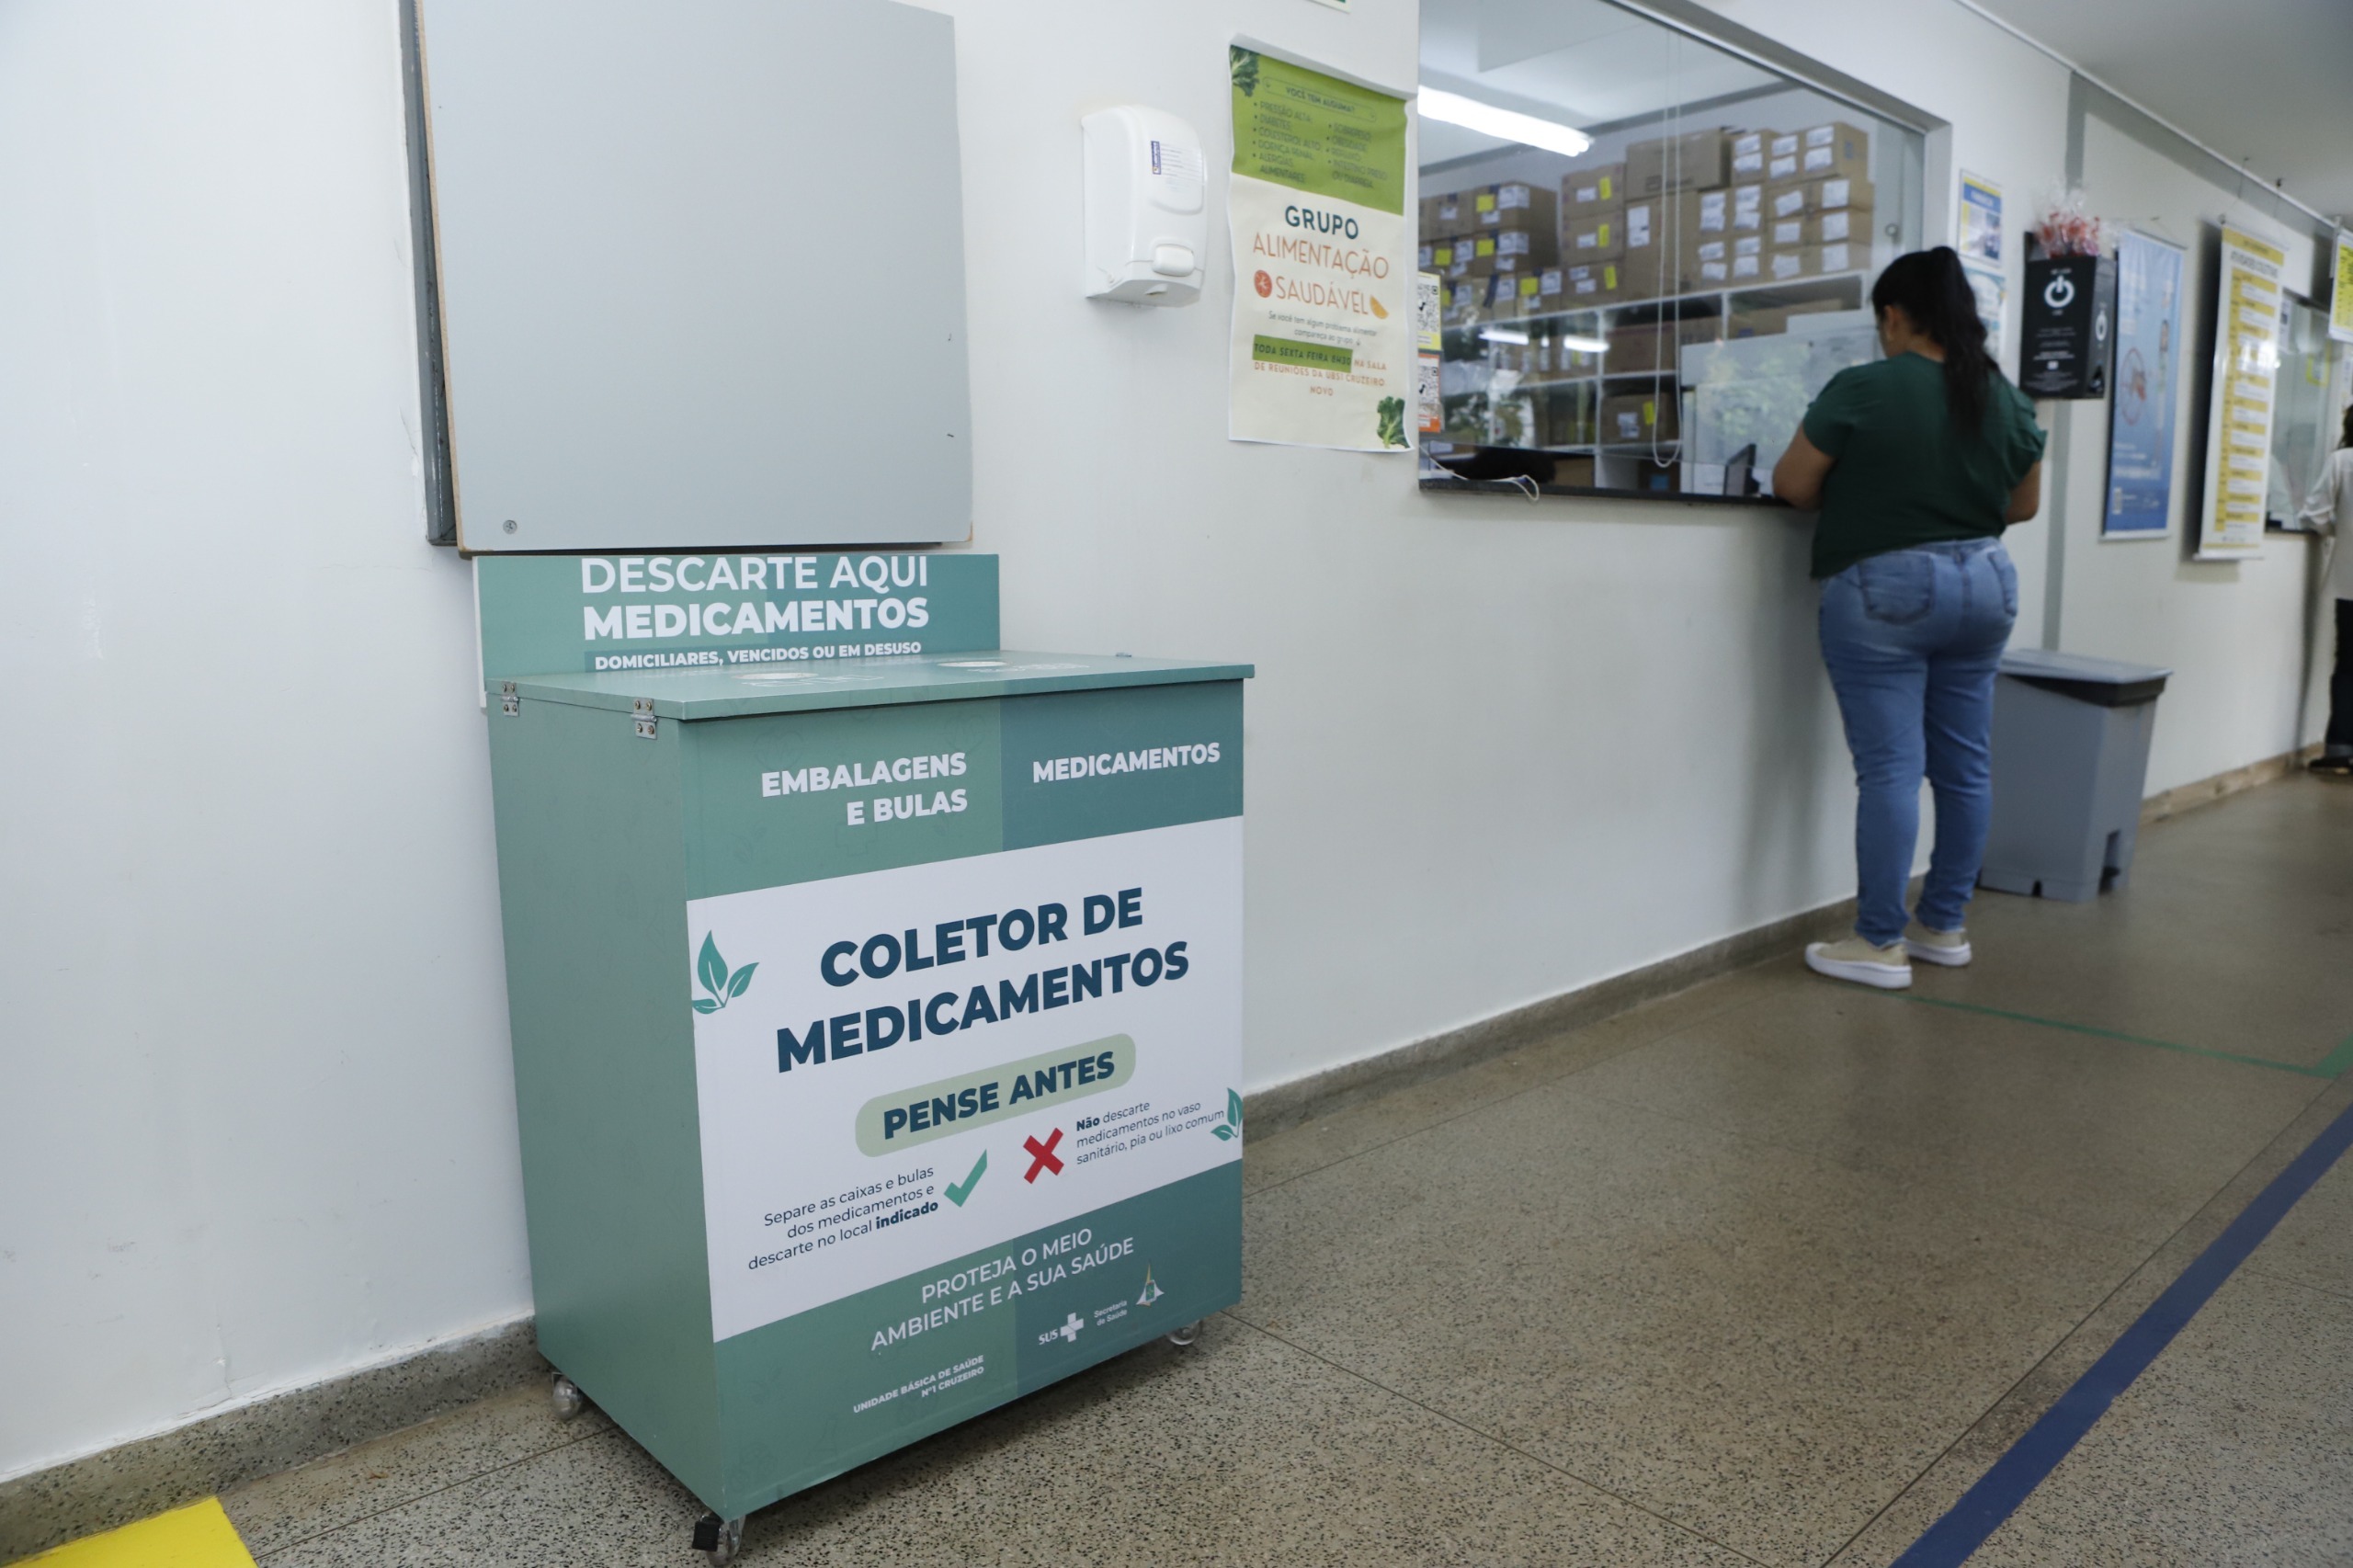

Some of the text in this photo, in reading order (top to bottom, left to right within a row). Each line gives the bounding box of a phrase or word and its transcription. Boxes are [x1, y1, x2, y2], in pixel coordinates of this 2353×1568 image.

[1285, 205, 1358, 240] GRUPO
[1253, 232, 1390, 279] ALIMENTAÇÃO
[1276, 275, 1369, 315] SAUDÁVEL
[1268, 311, 1277, 320] Se
[1278, 312, 1292, 323] você
[1254, 361, 1266, 371] DE
[1268, 363, 1310, 377] REUNIÕES
[1312, 369, 1324, 379] DA
[1346, 374, 1385, 387] CRUZEIRO
[1255, 343, 1277, 356] TODA
[1279, 347, 1304, 359] SEXTA
[1306, 351, 1328, 363] FEIRA
[1354, 358, 1365, 368] NA
[1367, 359, 1387, 371] SALA
[1310, 386, 1334, 397] NOVO
[581, 556, 927, 594] DESCARTE AQUI
[583, 597, 929, 641] MEDICAMENTOS
[595, 642, 922, 671] DOMICILIARES, VENCIDOS OU EM DESUSO
[761, 752, 967, 798] EMBALAGENS
[1032, 743, 1221, 783] MEDICAMENTOS
[847, 789, 968, 826] E BULAS
[820, 887, 1143, 988] COLETOR DE
[777, 941, 1189, 1074] MEDICAMENTOS
[883, 1051, 1116, 1140] PENSE ANTES
[1076, 1102, 1151, 1131] Não descarte
[1076, 1102, 1201, 1148] medicamentos no vaso
[1076, 1109, 1225, 1165] sanitário, pia ou lixo comum
[764, 1165, 934, 1227] Separe as caixas e bulas
[787, 1184, 935, 1239] dos medicamentos e
[748, 1201, 938, 1270] descarte no local indicado
[921, 1228, 1092, 1303] PROTEJA O MEIO
[870, 1237, 1134, 1351] AMBIENTE E A SUA SAÚDE
[1094, 1300, 1128, 1318] Secretaria
[1038, 1328, 1059, 1346] SUS
[1097, 1309, 1128, 1326] de Saúde
[853, 1355, 984, 1414] UNIDADE BÁSICA DE SAÚDE
[938, 1366, 984, 1391] CRUZEIRO
